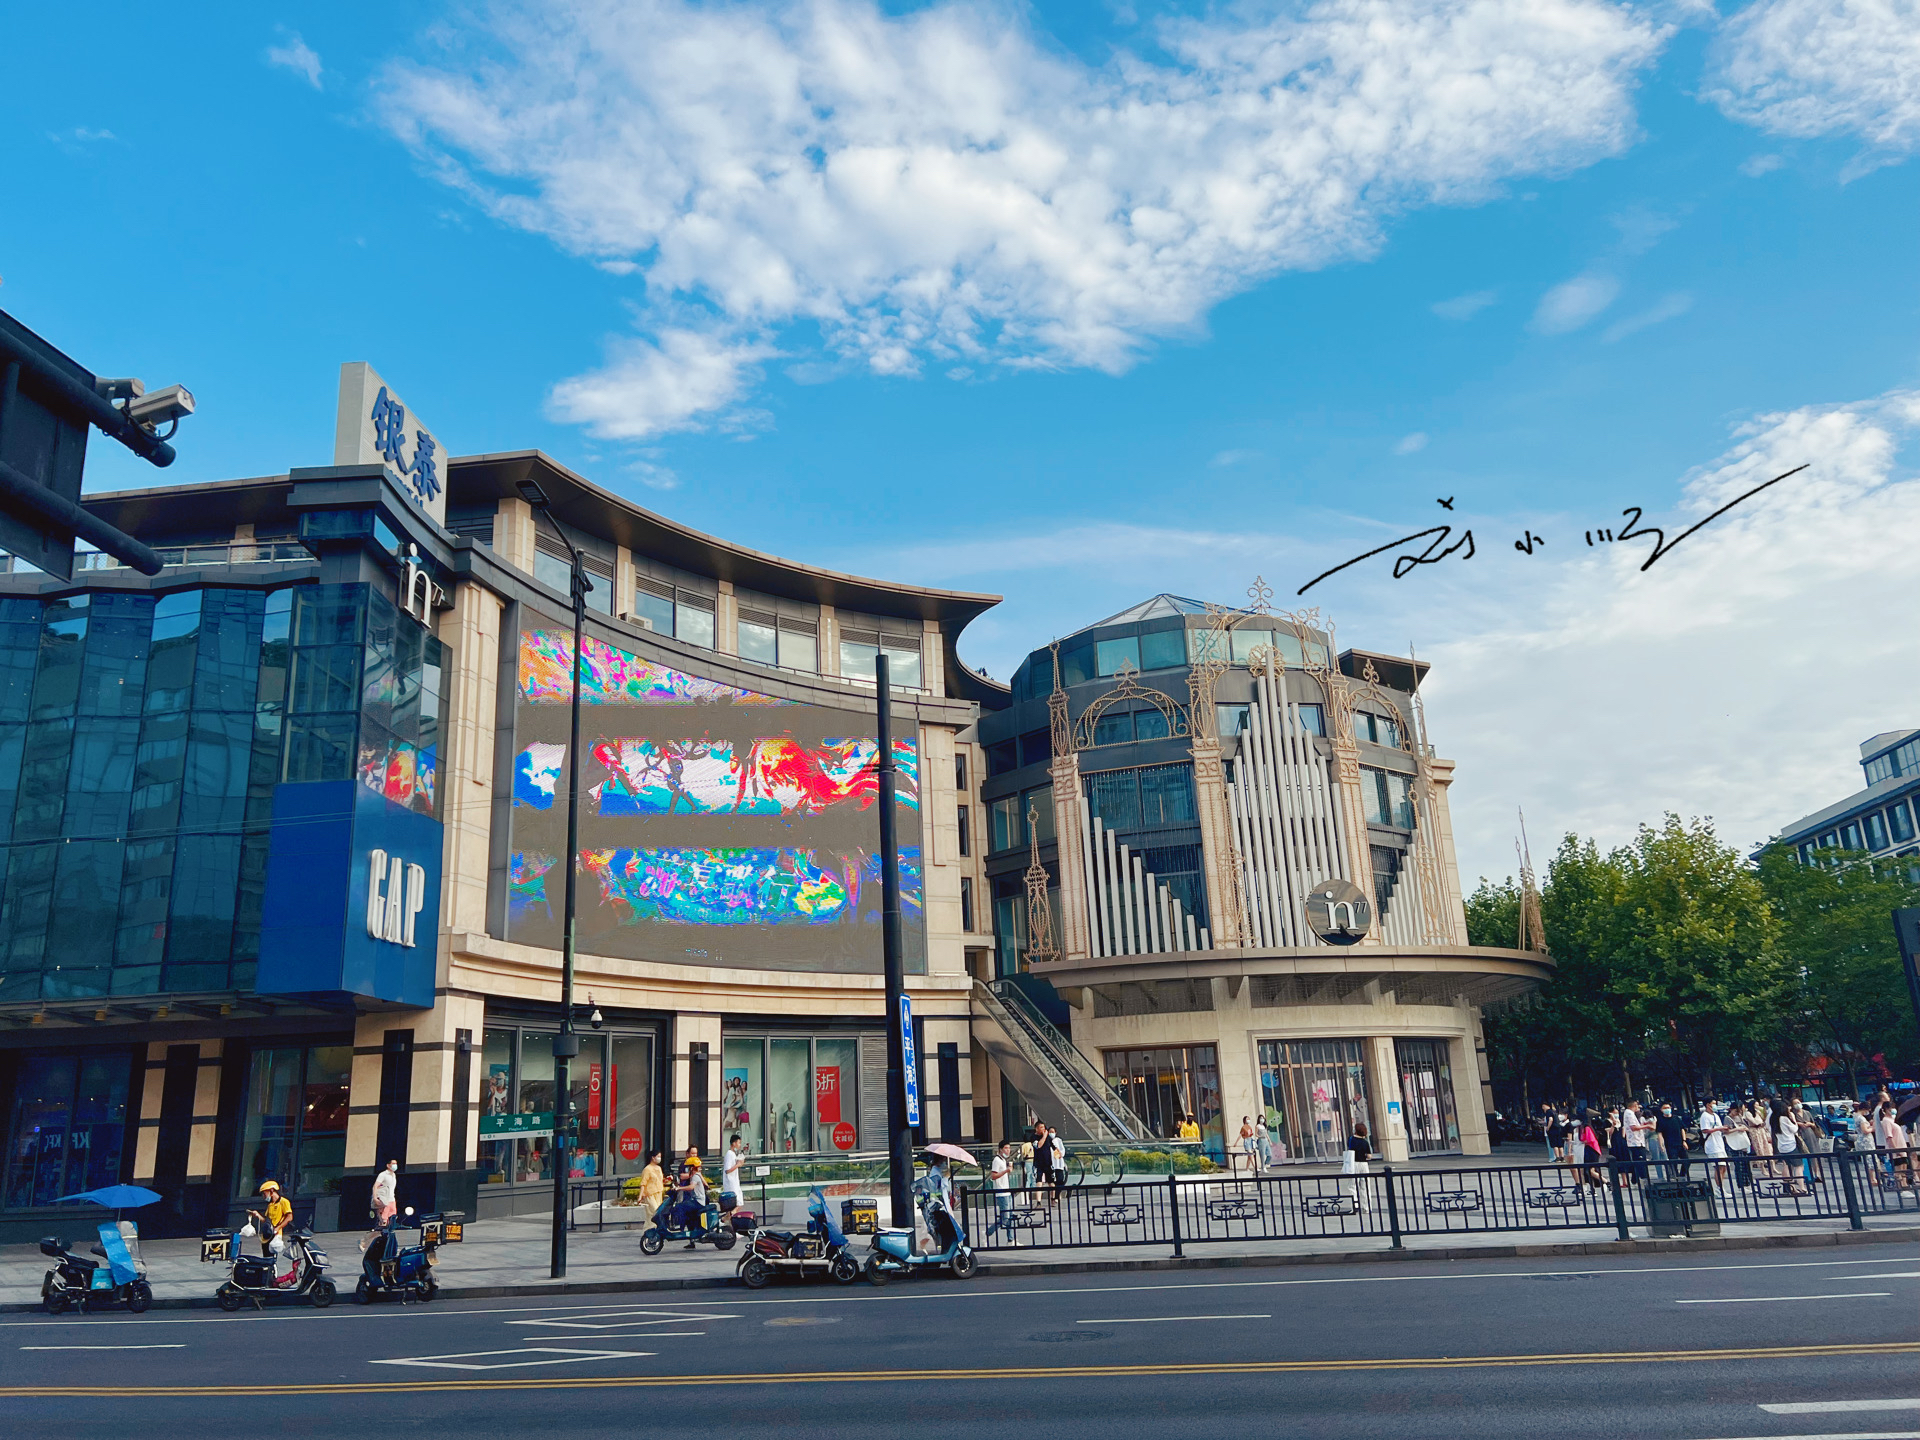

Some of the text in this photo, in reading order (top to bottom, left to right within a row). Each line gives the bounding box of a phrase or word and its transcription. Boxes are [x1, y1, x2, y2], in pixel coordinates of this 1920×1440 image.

[371, 386, 442, 501] 银泰
[366, 848, 426, 948] GAP
[1325, 890, 1368, 930] in77
[591, 1072, 600, 1091] 5
[904, 1036, 915, 1115] 平海路
[496, 1116, 541, 1127] 平海路
[621, 1142, 640, 1152] 大减价
[835, 1135, 854, 1143] 大减价
